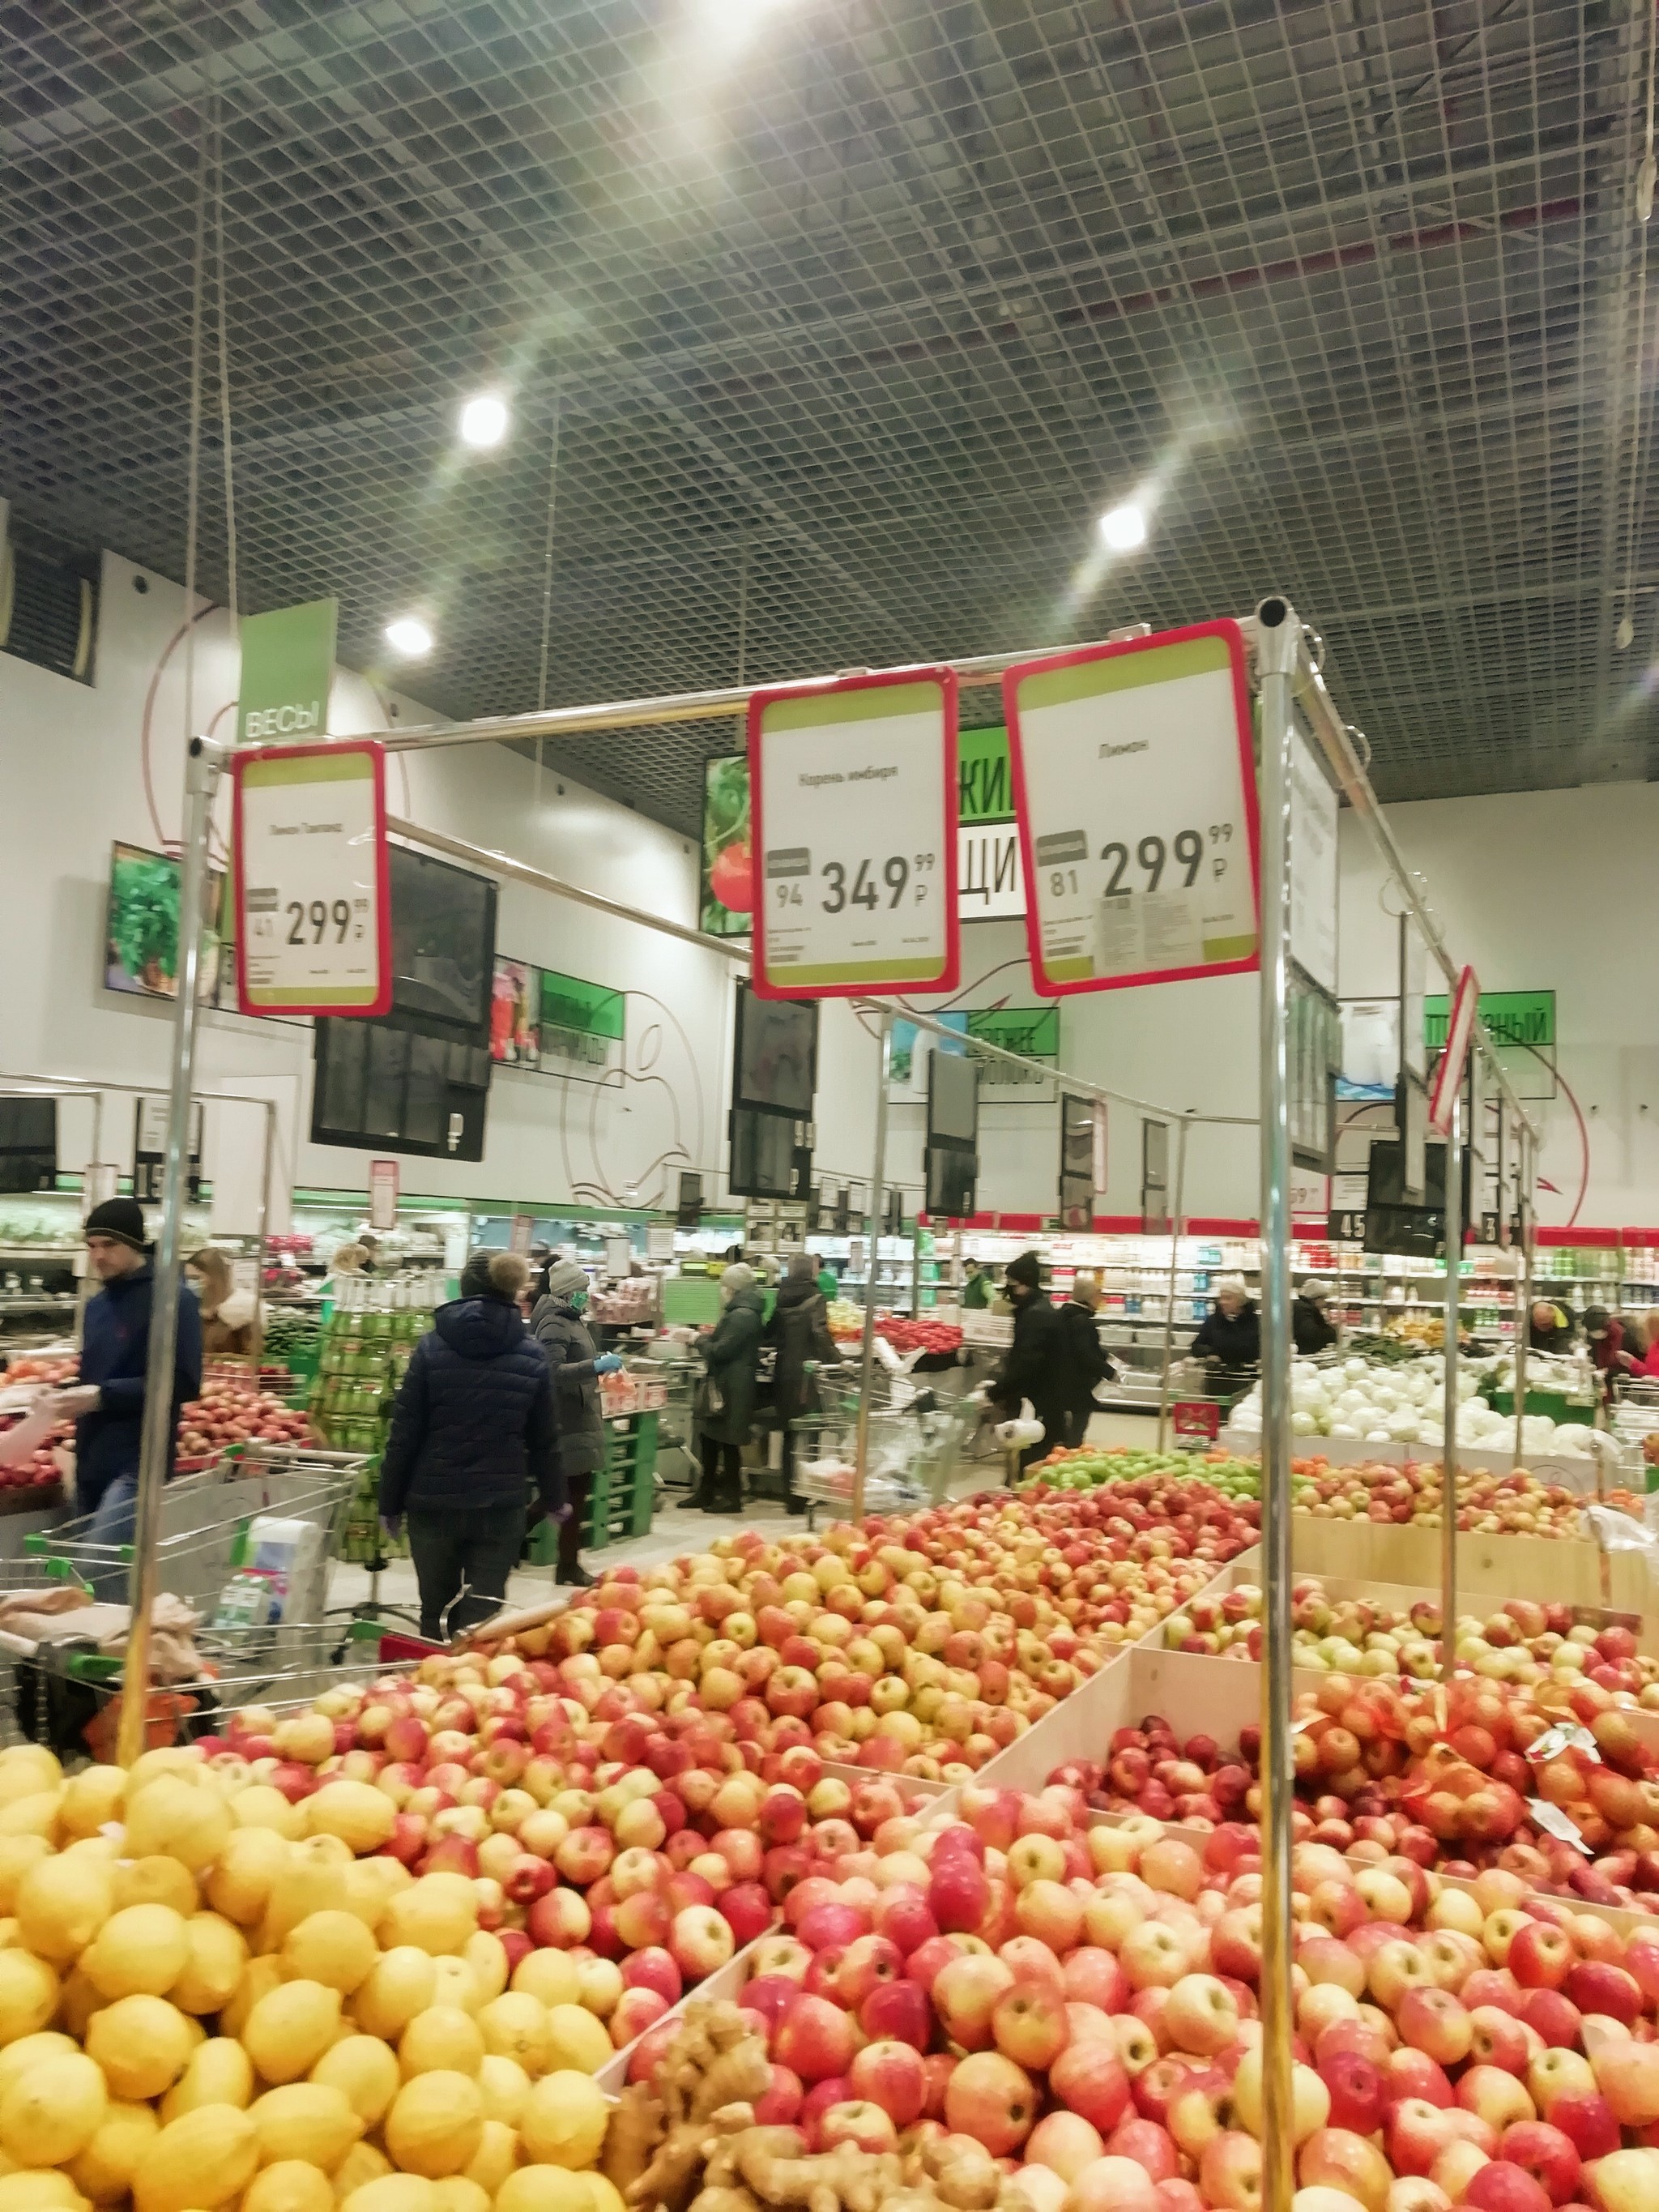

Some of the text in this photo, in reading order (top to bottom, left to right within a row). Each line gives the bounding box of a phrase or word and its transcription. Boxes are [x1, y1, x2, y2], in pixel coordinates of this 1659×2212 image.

[245, 700, 320, 737] ВЕСЫ
[1098, 739, 1149, 759] Лимон
[1099, 829, 1204, 898] 299
[1209, 823, 1234, 845] 99
[776, 883, 804, 907] 94
[820, 855, 910, 914] 349
[914, 853, 935, 872] 99
[1050, 869, 1079, 897] 81
[286, 899, 352, 946] 299
